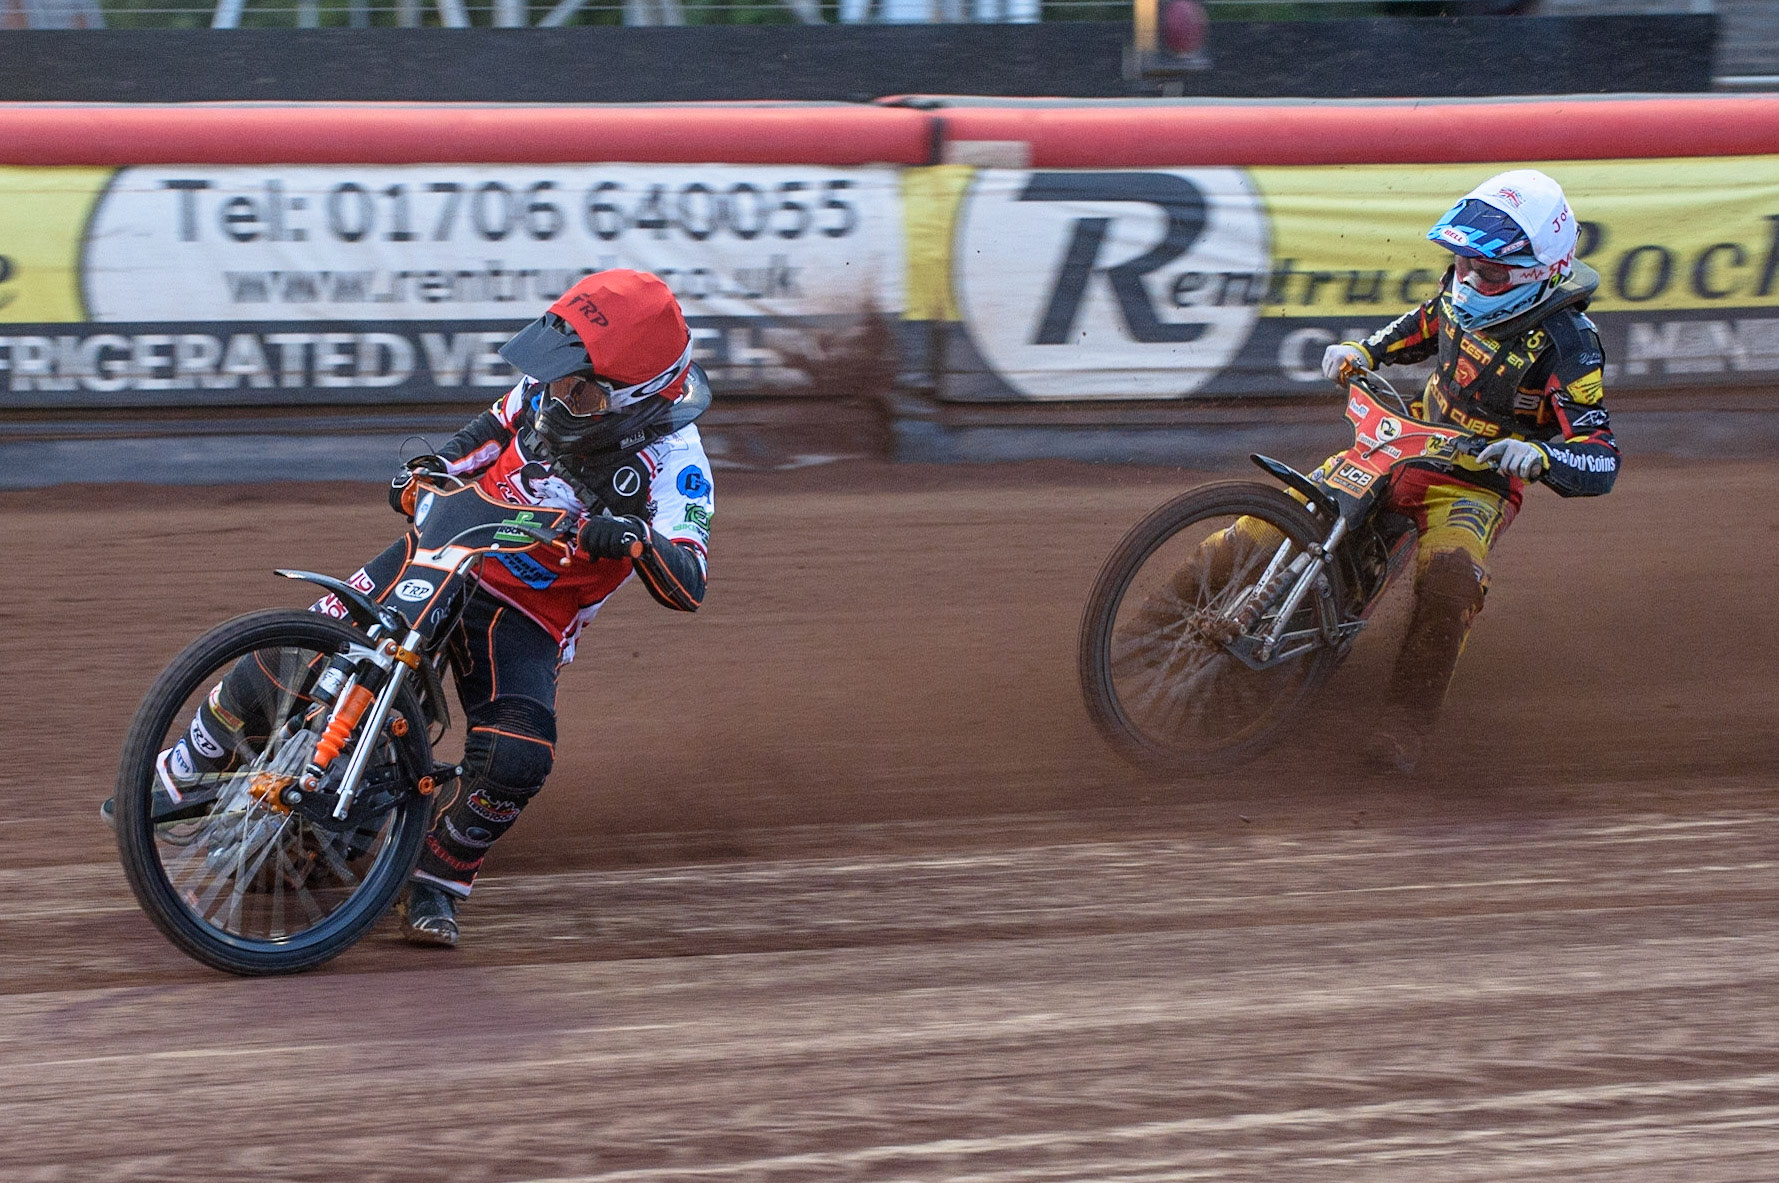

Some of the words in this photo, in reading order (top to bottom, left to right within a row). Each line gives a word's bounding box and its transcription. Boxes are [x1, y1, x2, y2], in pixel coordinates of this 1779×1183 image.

[162, 178, 311, 243] Tel:
[322, 180, 567, 242] 01706
[584, 178, 862, 241] 640055
[1444, 229, 1463, 243] BELL
[1450, 407, 1500, 437] CUBS
[1339, 466, 1373, 487] JCB
[401, 581, 430, 598] FRP
